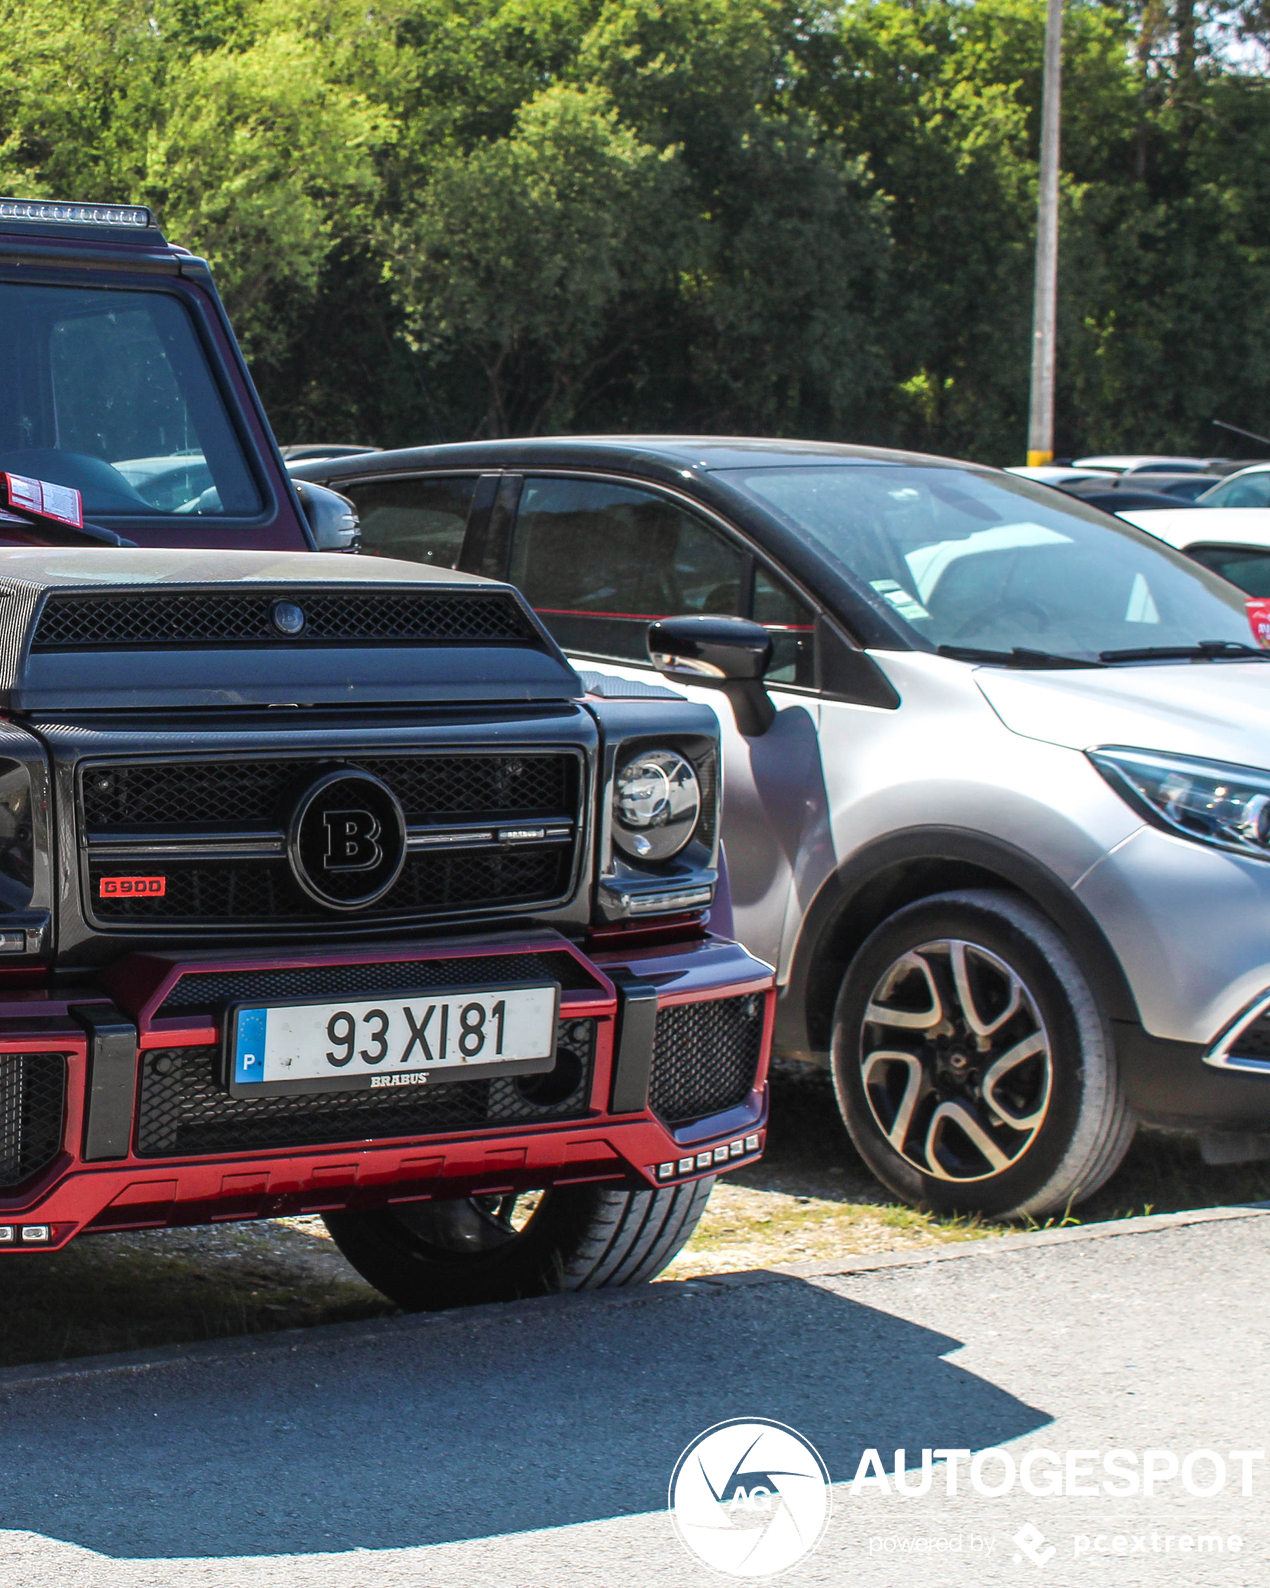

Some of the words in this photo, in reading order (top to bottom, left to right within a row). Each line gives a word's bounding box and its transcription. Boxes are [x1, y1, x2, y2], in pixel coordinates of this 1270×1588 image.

[323, 809, 383, 873] B
[326, 1009, 390, 1067] 93
[400, 1004, 449, 1063] XI
[458, 1000, 506, 1057] 81
[243, 1054, 256, 1070] P
[370, 1072, 428, 1088] BRABUS
